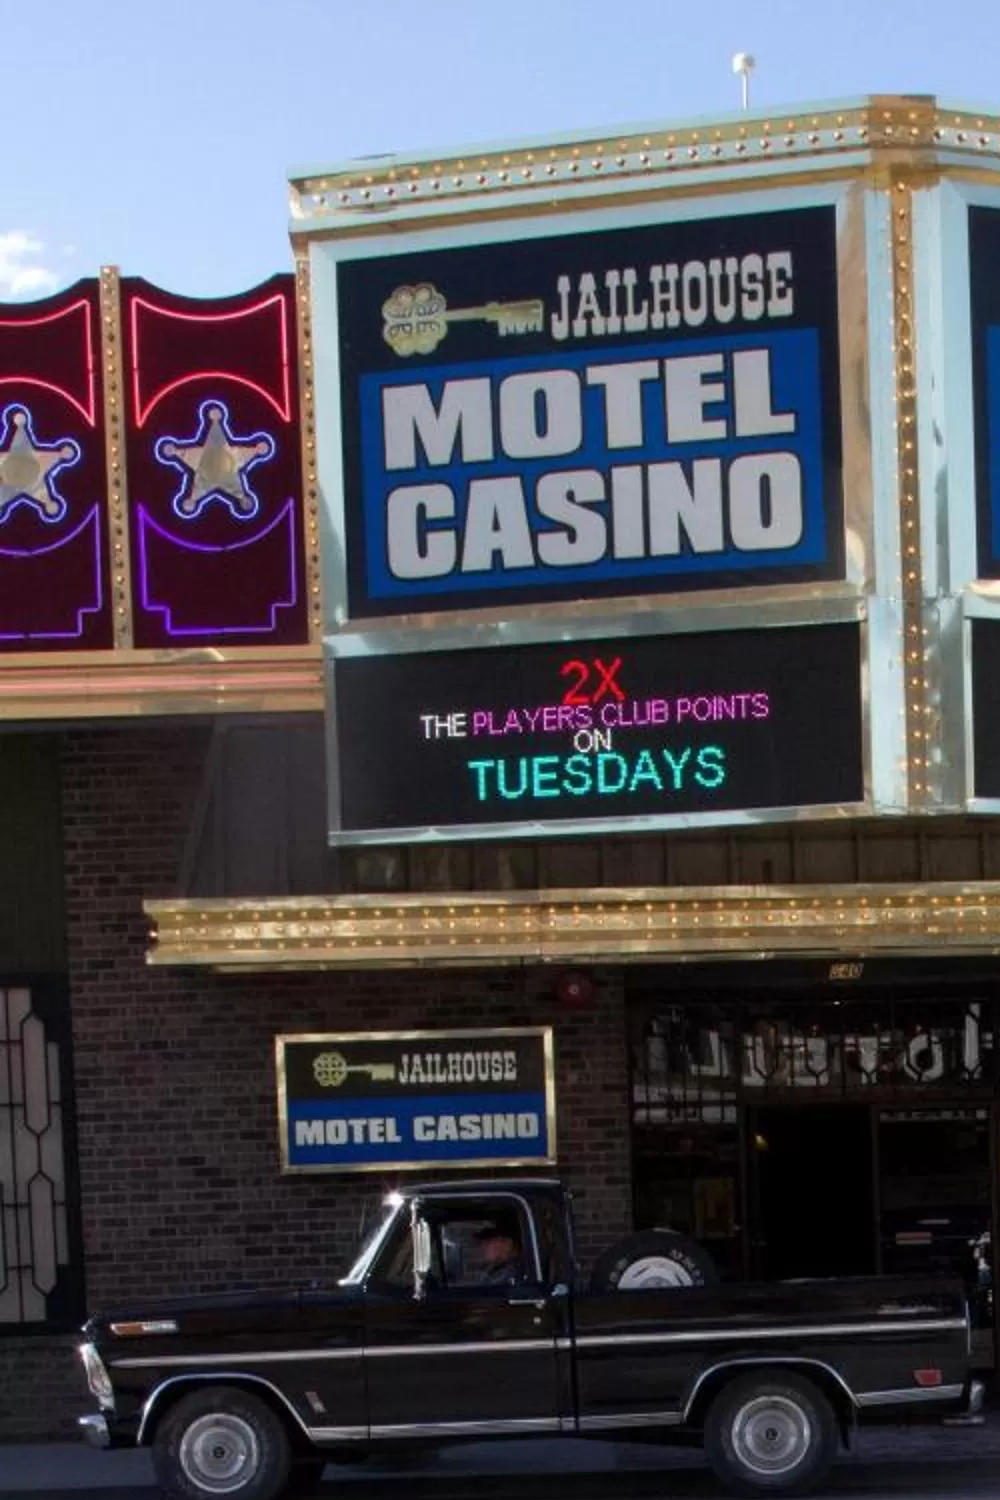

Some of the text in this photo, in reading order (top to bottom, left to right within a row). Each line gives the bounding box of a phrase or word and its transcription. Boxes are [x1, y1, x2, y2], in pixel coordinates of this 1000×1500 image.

[551, 252, 794, 340] JAILHOUSE
[382, 348, 795, 471] MOTEL
[386, 452, 802, 579] CASINO
[559, 657, 625, 705] 2X
[420, 693, 769, 738] THE PLAYERS CLUB POINTS
[574, 729, 612, 754] ON
[468, 747, 726, 801] TUESDAYS
[399, 1051, 516, 1084] JAILHOUSE
[295, 1113, 539, 1146] MOTEL CASINO
